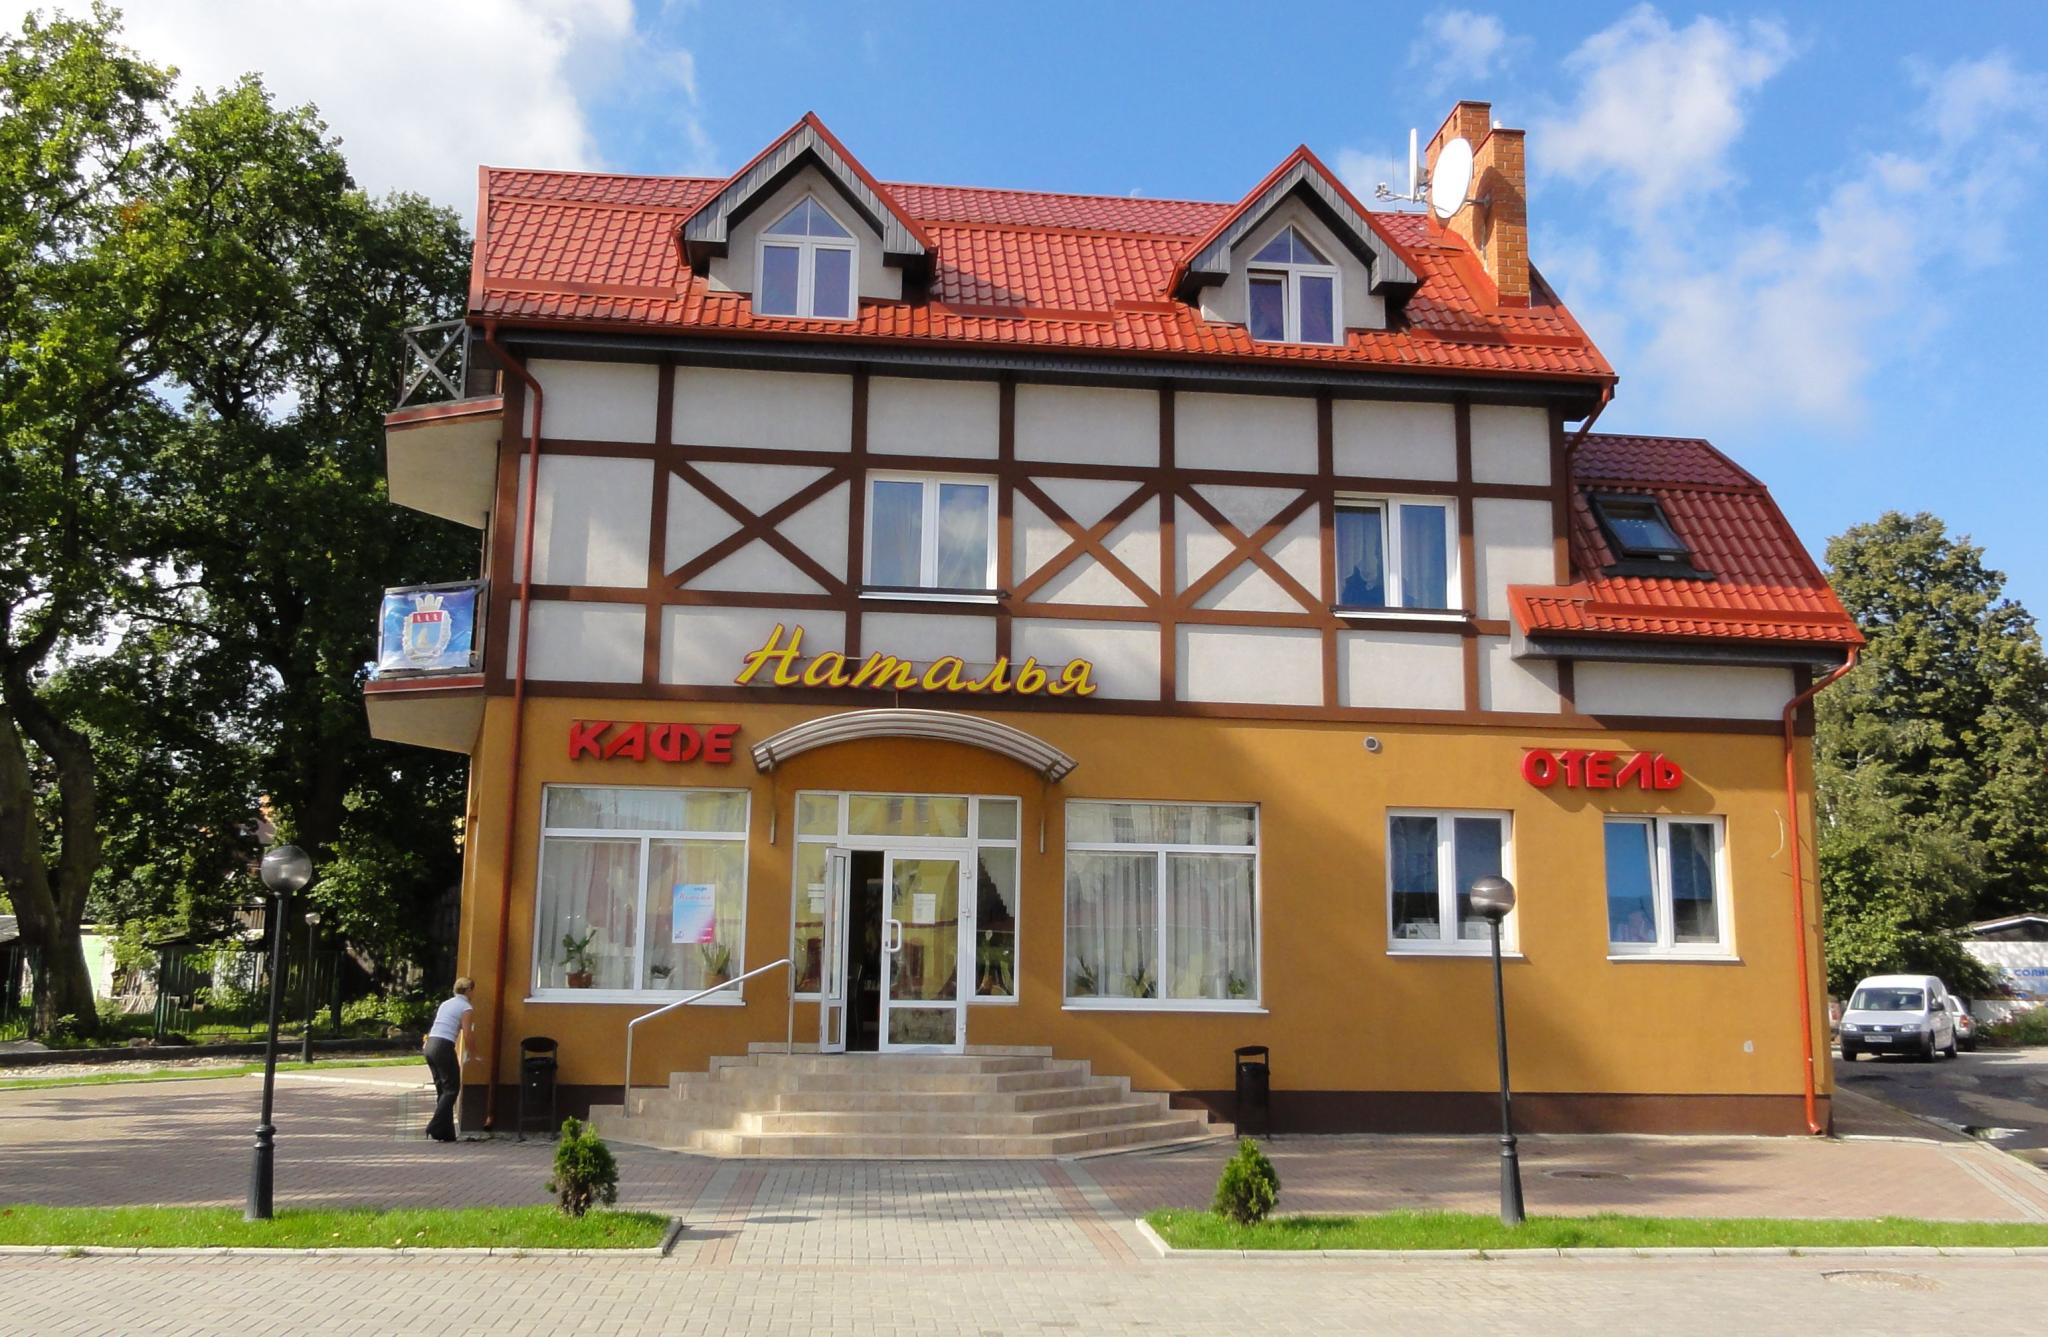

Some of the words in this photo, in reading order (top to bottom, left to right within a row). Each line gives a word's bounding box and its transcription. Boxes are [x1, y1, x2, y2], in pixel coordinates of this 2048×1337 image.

[734, 623, 1097, 696] Наталья
[568, 720, 741, 764] КАФЕ
[1520, 748, 1684, 790] ОТЕЛЬ
